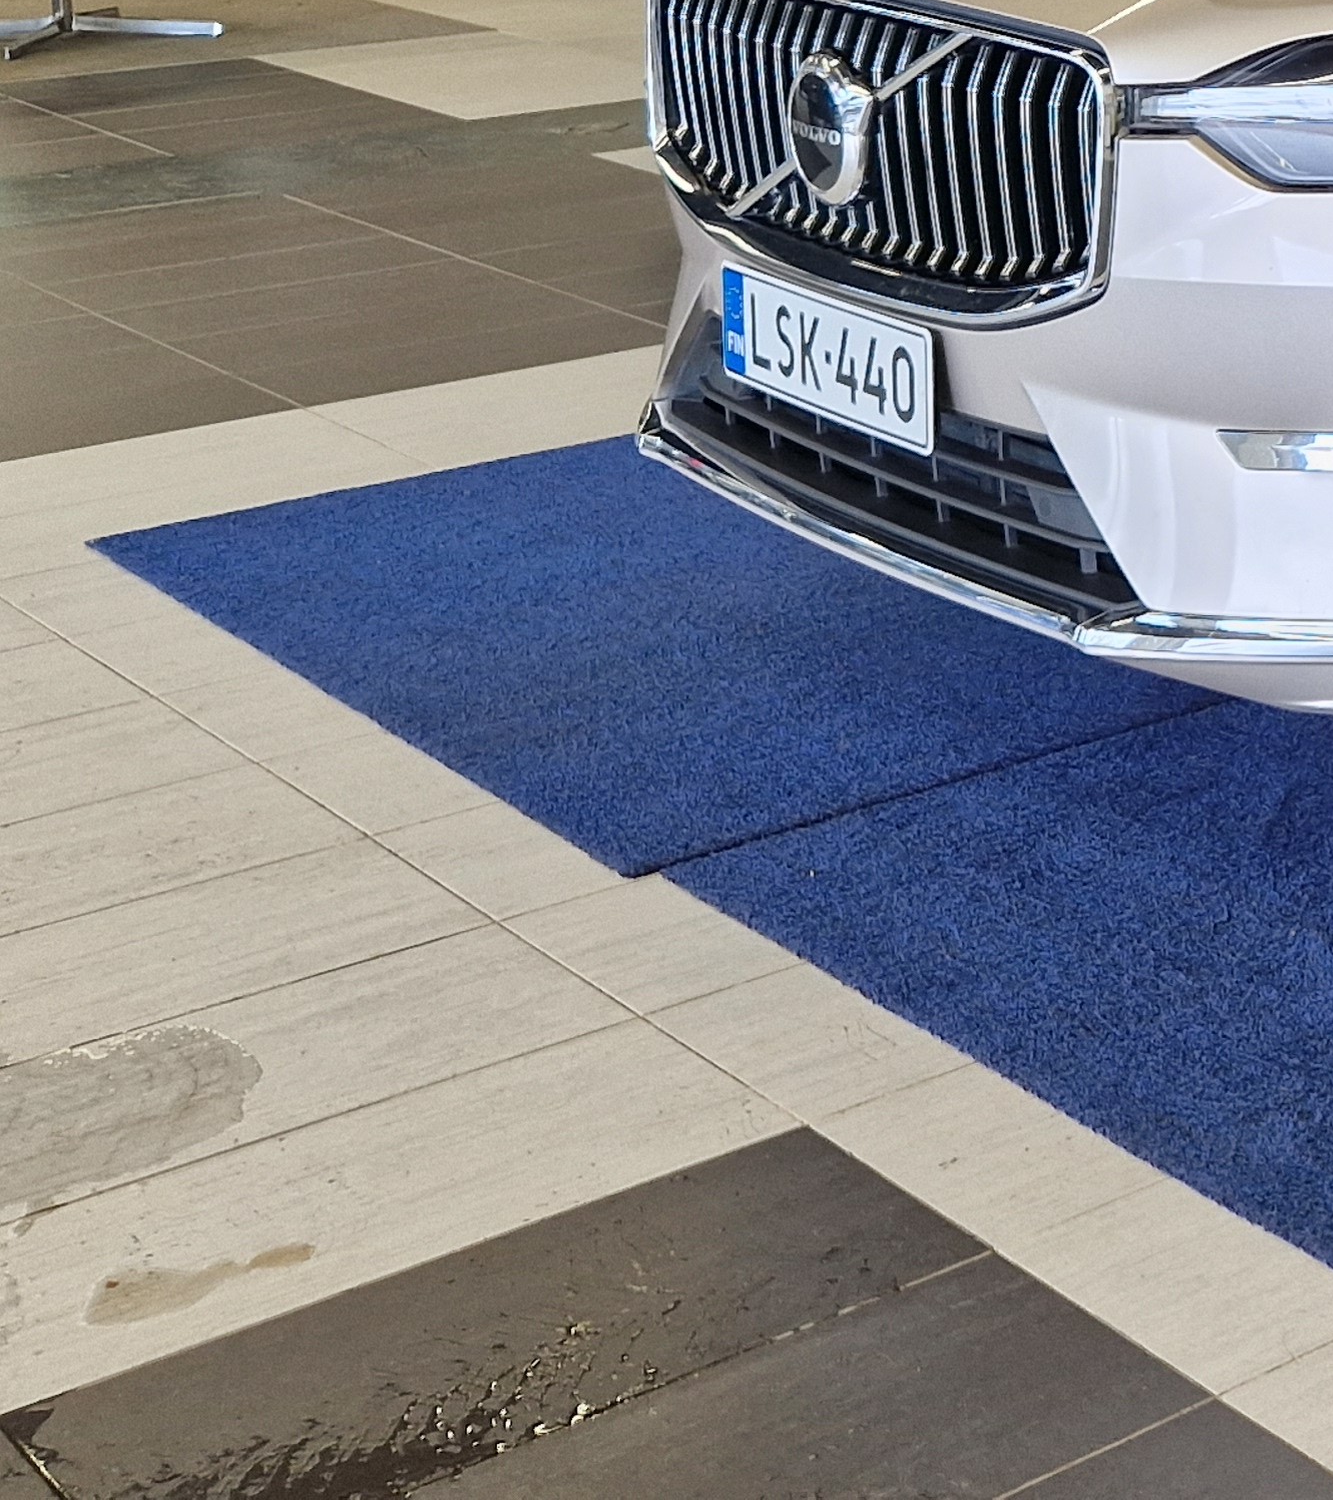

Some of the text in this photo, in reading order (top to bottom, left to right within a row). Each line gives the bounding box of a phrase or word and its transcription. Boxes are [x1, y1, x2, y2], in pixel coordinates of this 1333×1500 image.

[793, 119, 841, 146] VOLVO
[728, 329, 746, 357] FIN
[750, 292, 916, 423] LSK-440
